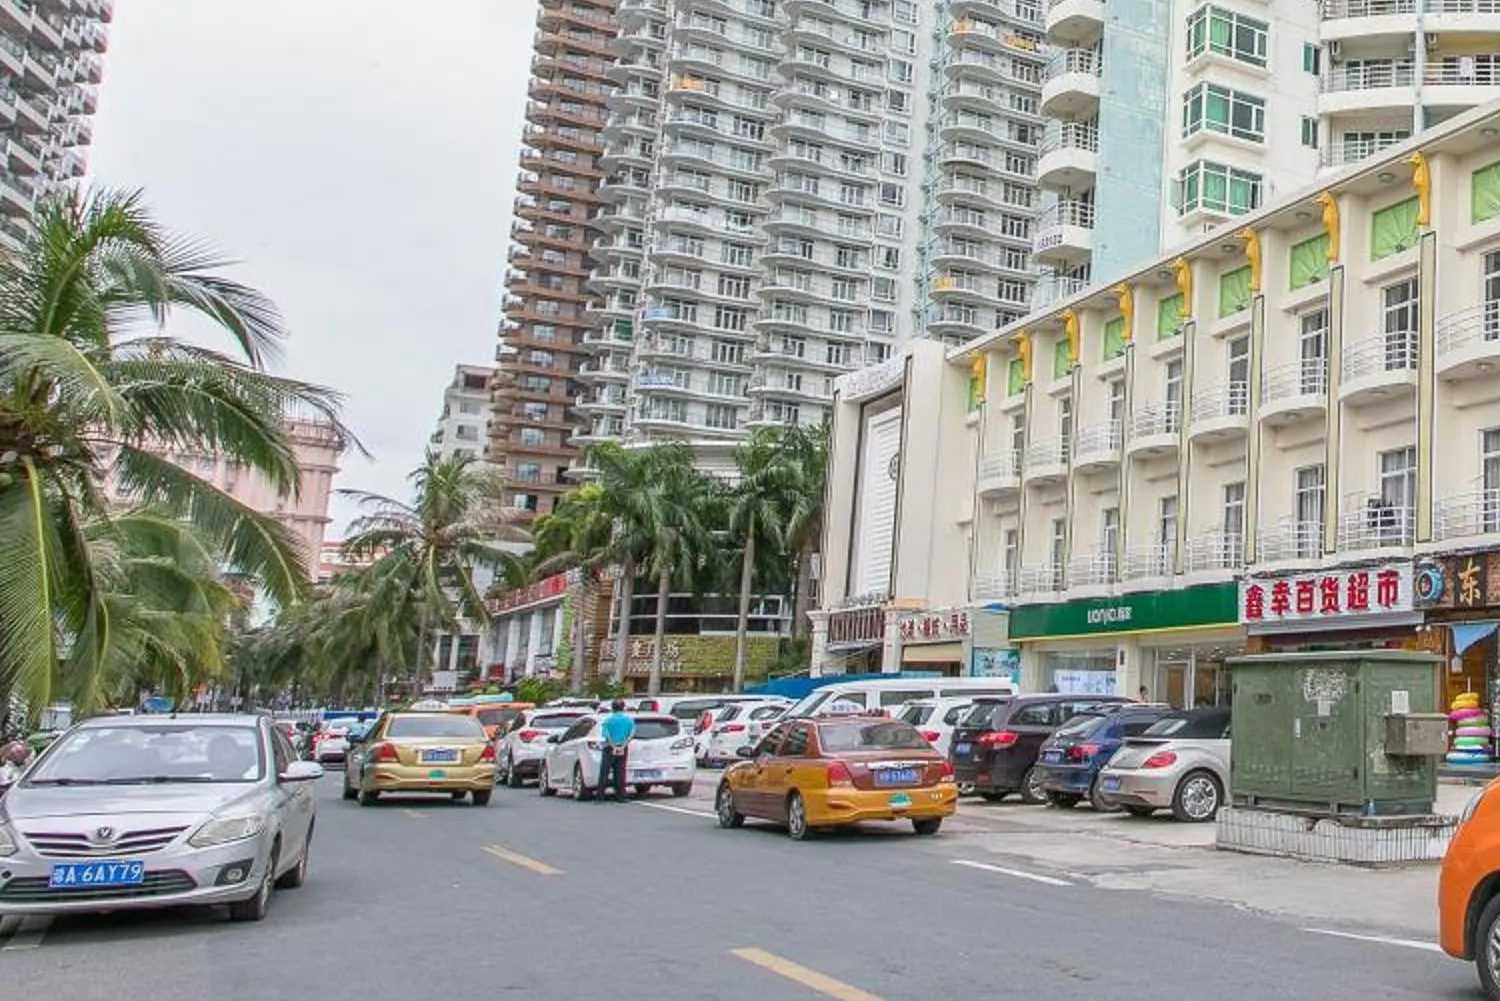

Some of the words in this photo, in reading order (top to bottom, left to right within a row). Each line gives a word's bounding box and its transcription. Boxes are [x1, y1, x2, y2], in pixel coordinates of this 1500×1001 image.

[1245, 568, 1400, 620] 鑫幸百货超市
